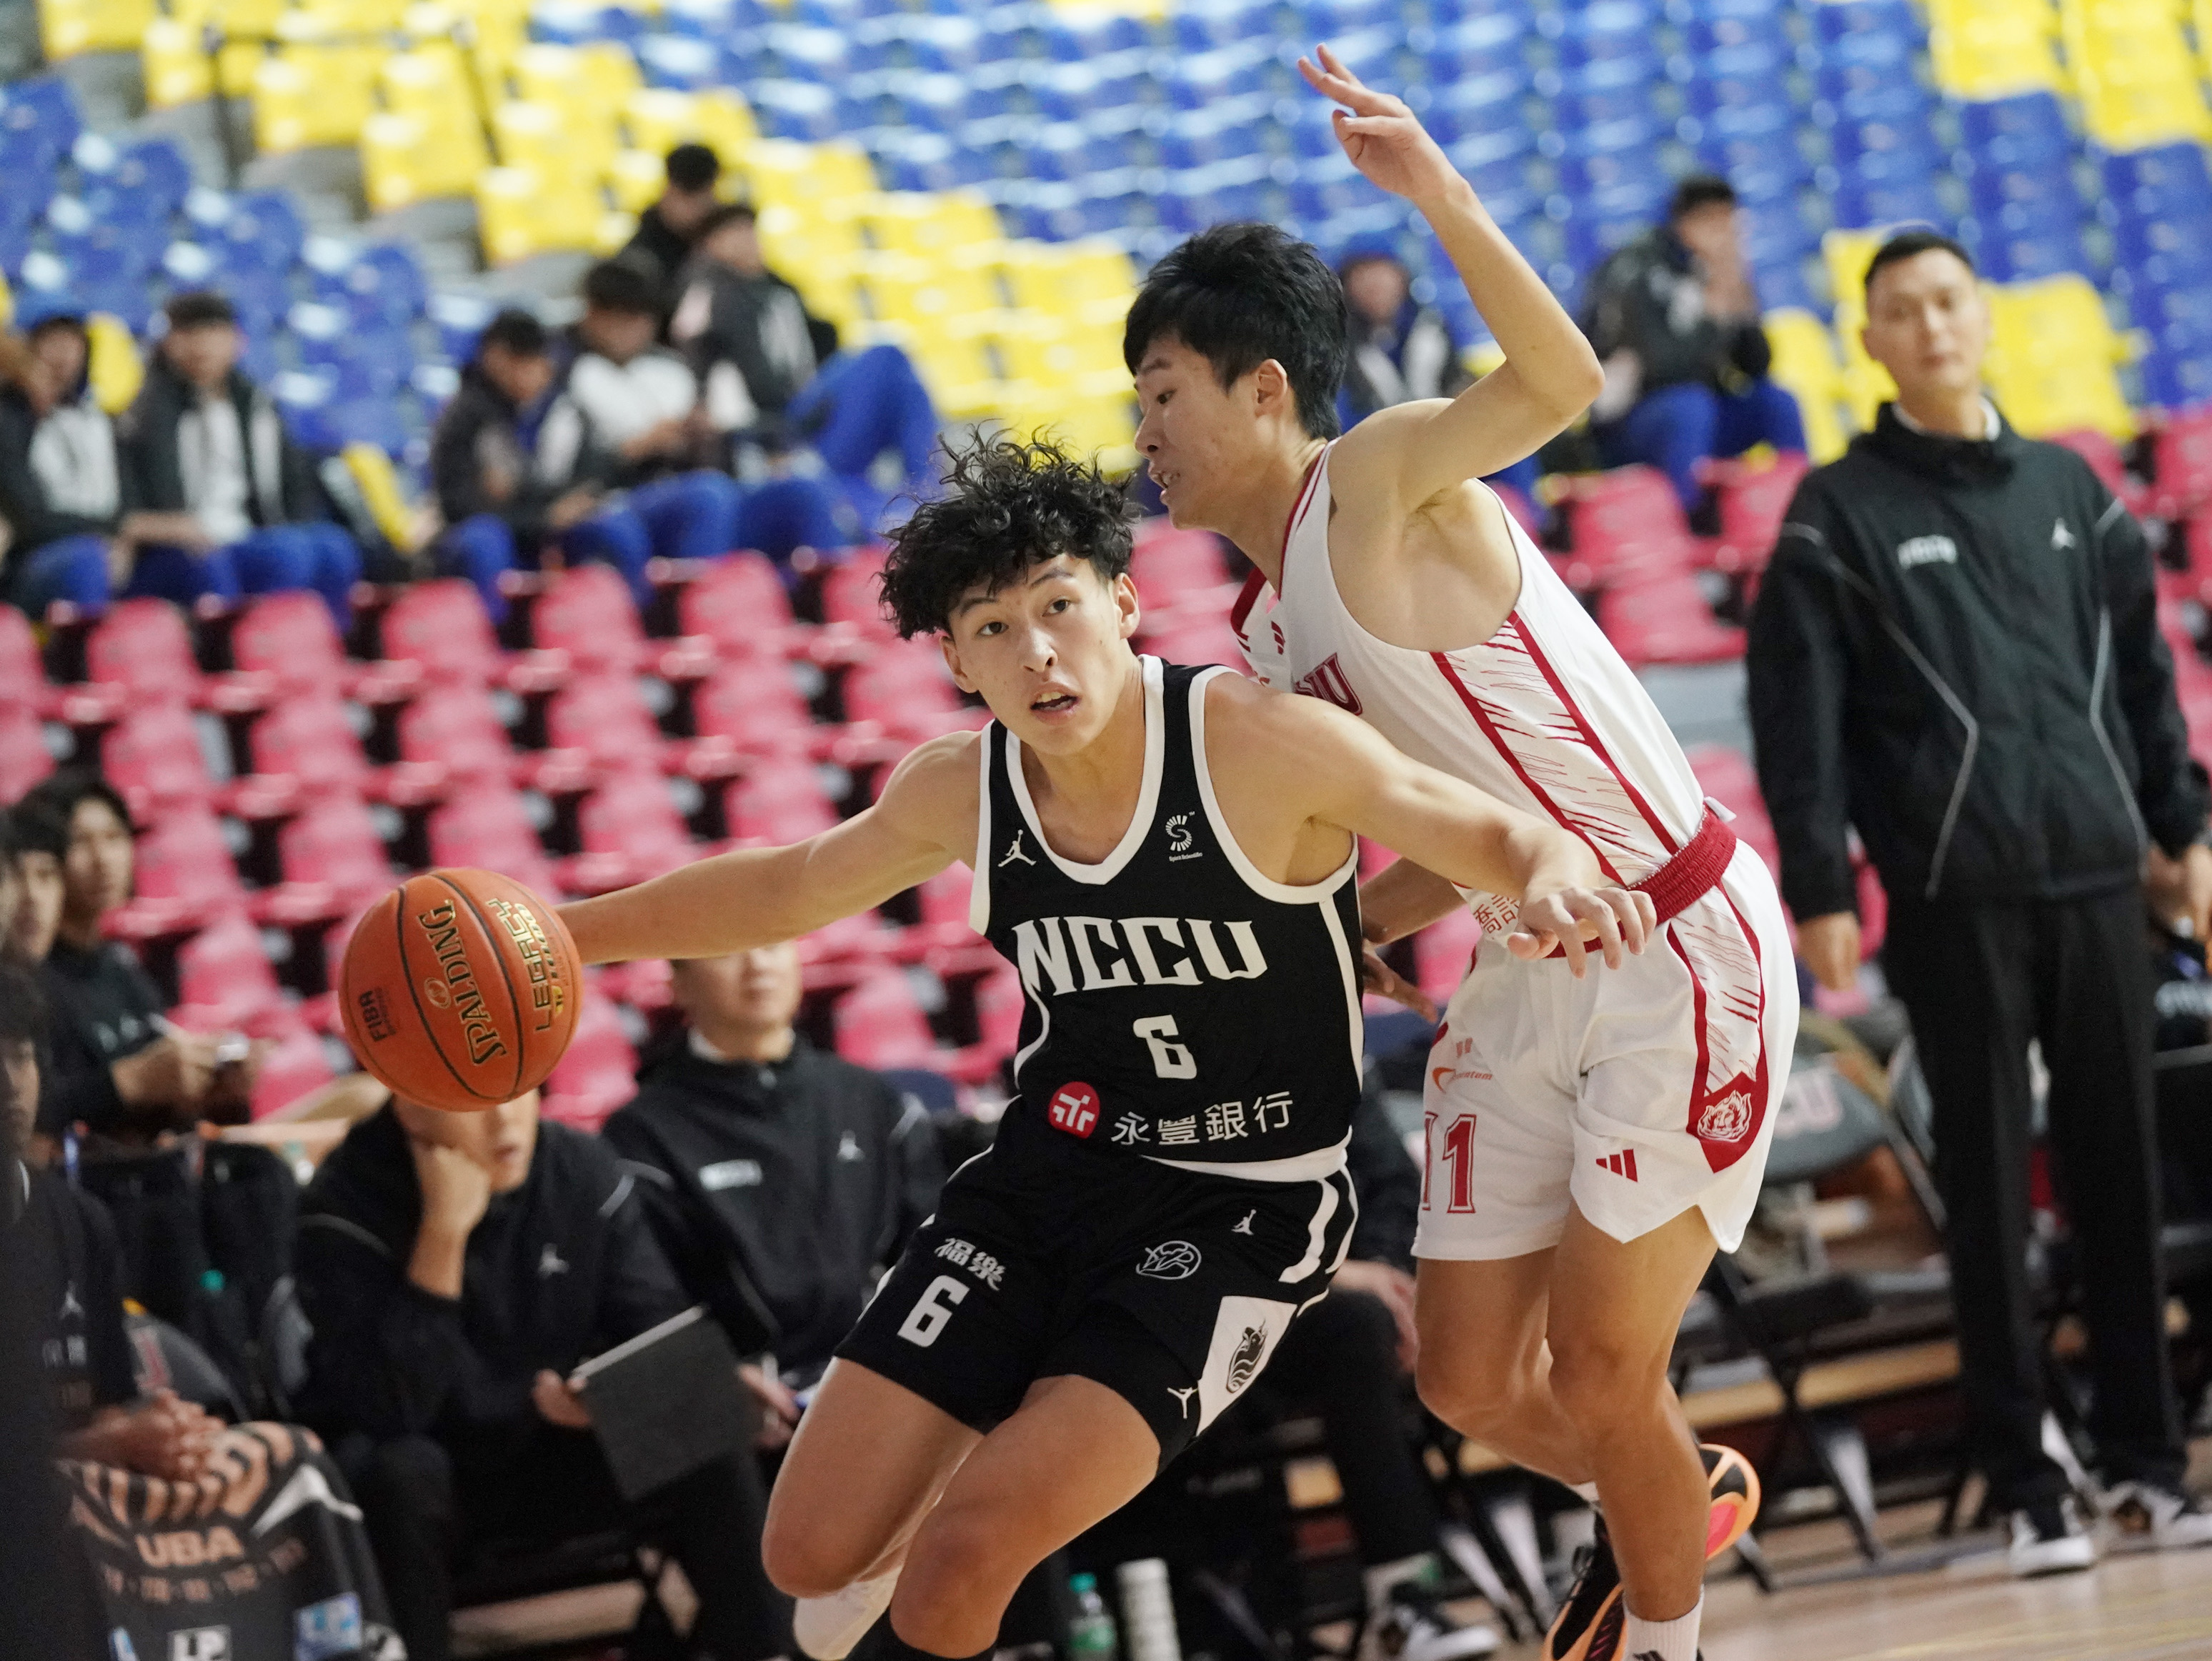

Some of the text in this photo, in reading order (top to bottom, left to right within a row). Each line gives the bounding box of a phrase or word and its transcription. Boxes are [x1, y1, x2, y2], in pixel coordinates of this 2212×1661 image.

[1295, 652, 1363, 716] U
[417, 899, 507, 1066] SPALDING
[486, 897, 551, 1031] LEGACY
[1012, 915, 1268, 997] NCCU
[1132, 1014, 1197, 1079] 6
[1110, 1091, 1293, 1145] 永豐銀行
[934, 1237, 1006, 1291] 福樂
[897, 1275, 970, 1348] 6
